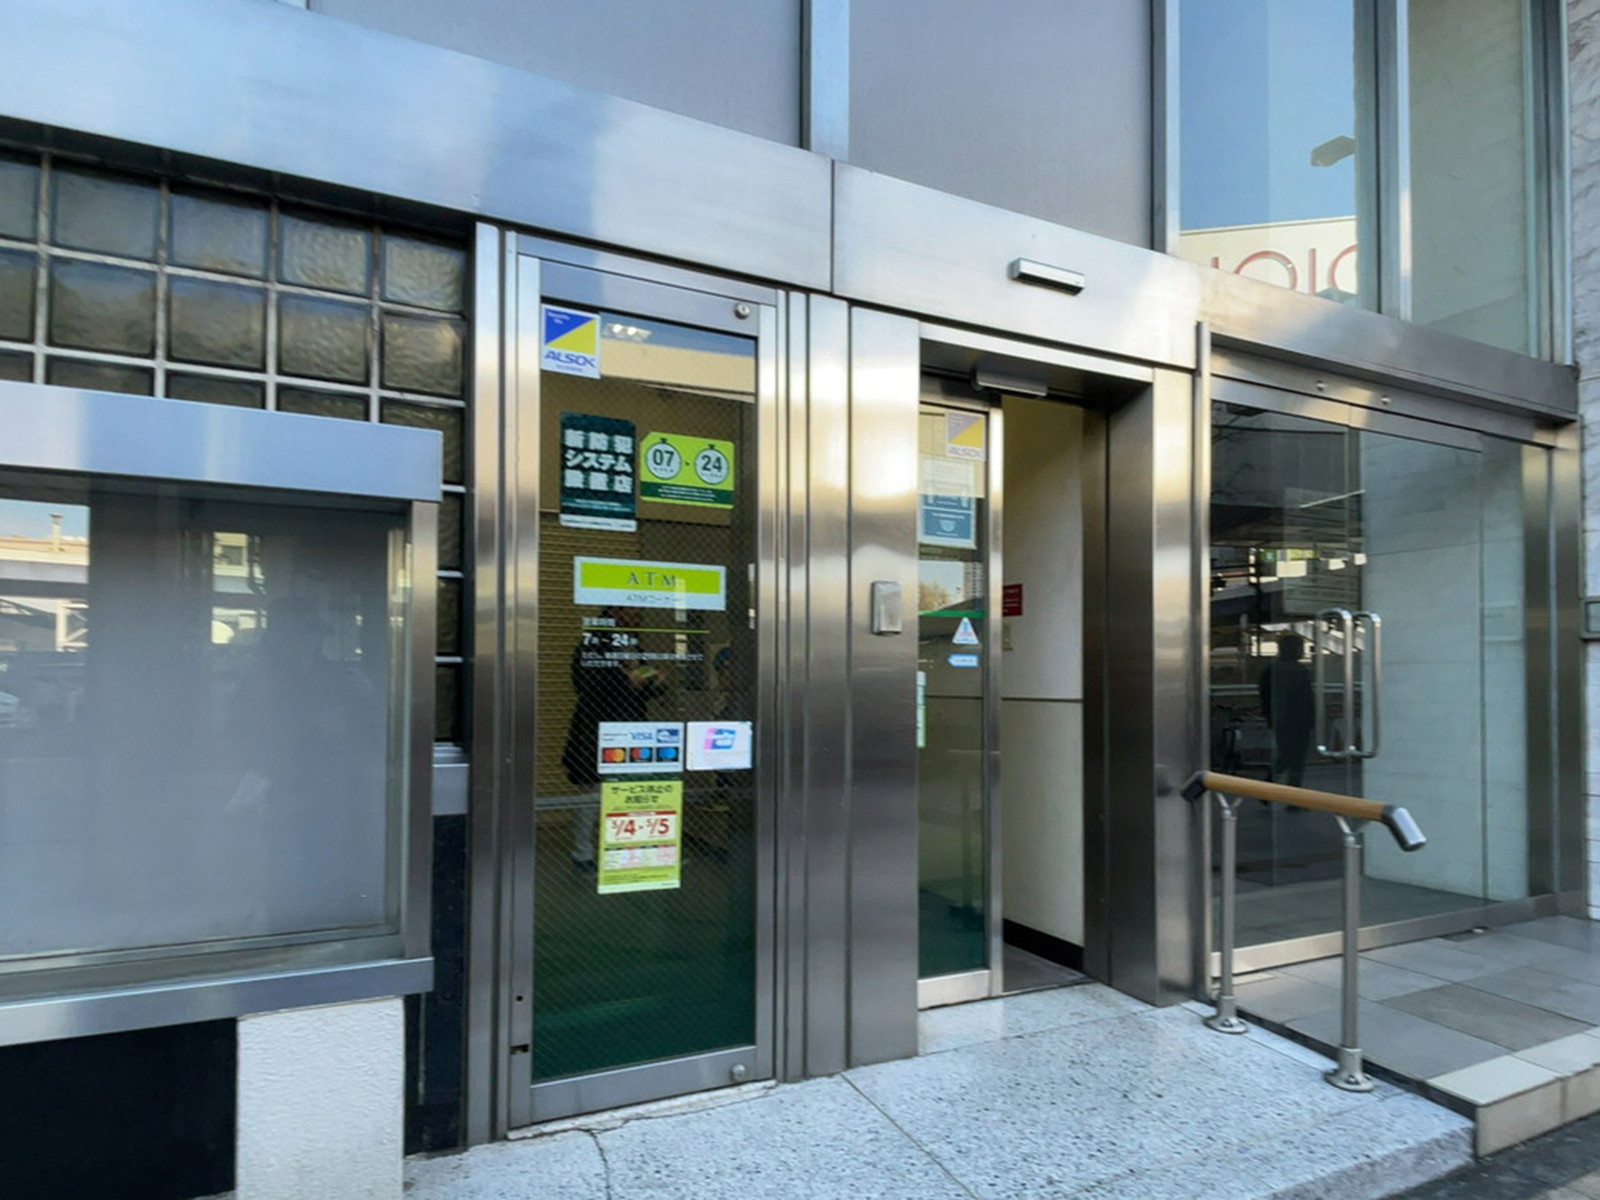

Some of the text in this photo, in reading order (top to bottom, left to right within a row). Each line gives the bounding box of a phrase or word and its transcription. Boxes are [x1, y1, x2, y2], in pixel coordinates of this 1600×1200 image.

[564, 449, 633, 473] システム
[653, 449, 675, 467] 07
[701, 454, 723, 473] 24
[626, 571, 677, 588] ATM
